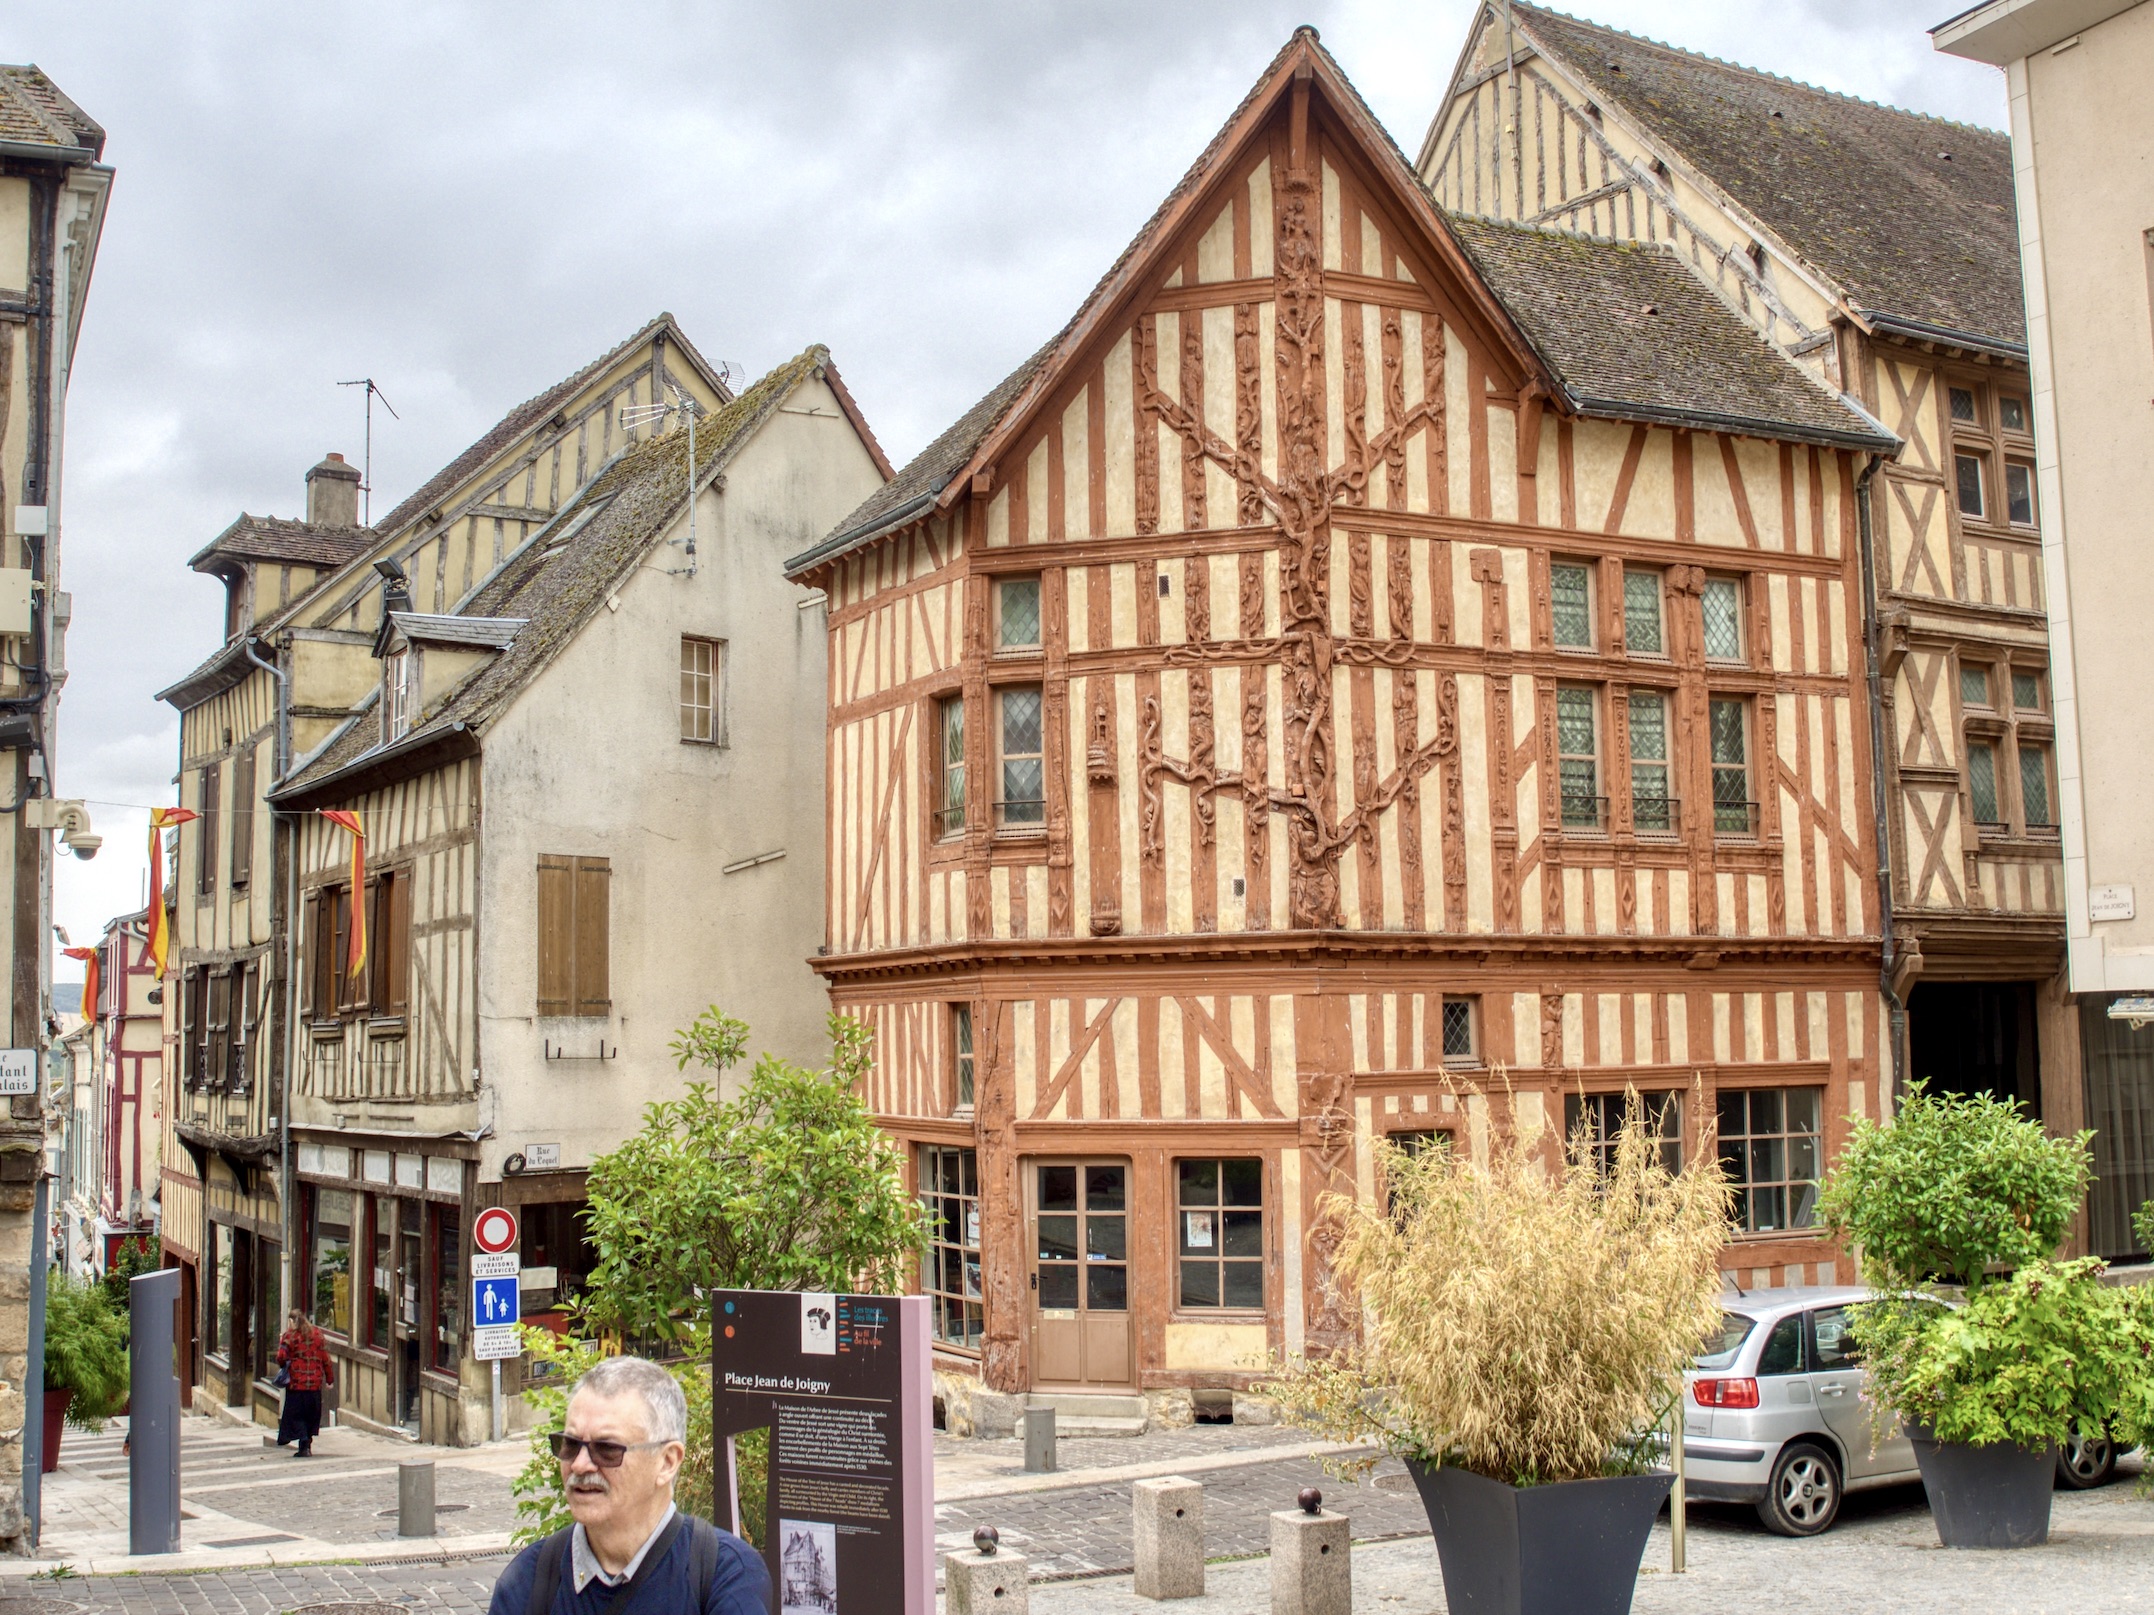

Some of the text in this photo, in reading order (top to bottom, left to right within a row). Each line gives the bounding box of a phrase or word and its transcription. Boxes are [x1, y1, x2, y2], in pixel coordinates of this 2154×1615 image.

[2111, 902, 2130, 910] JOIGNY
[536, 1146, 550, 1155] Rue
[528, 1157, 536, 1165] du
[853, 1337, 862, 1345] de
[725, 1372, 830, 1394] Place Jean de Joigny
